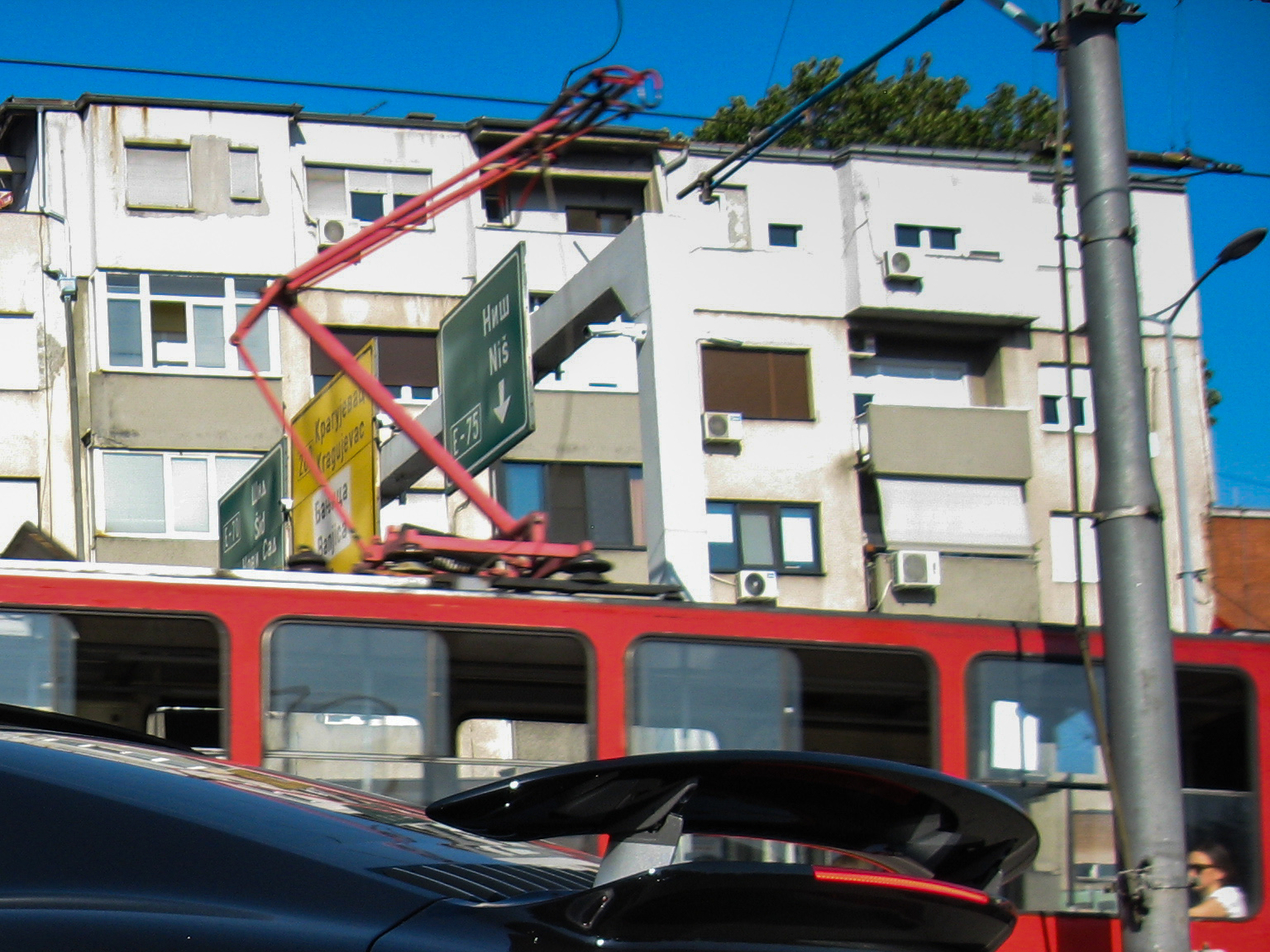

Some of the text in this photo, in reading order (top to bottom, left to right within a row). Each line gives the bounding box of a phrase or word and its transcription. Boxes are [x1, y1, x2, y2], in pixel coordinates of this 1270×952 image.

[482, 294, 510, 337] Ниш
[489, 334, 509, 376] Niš
[452, 410, 479, 456] E-75
